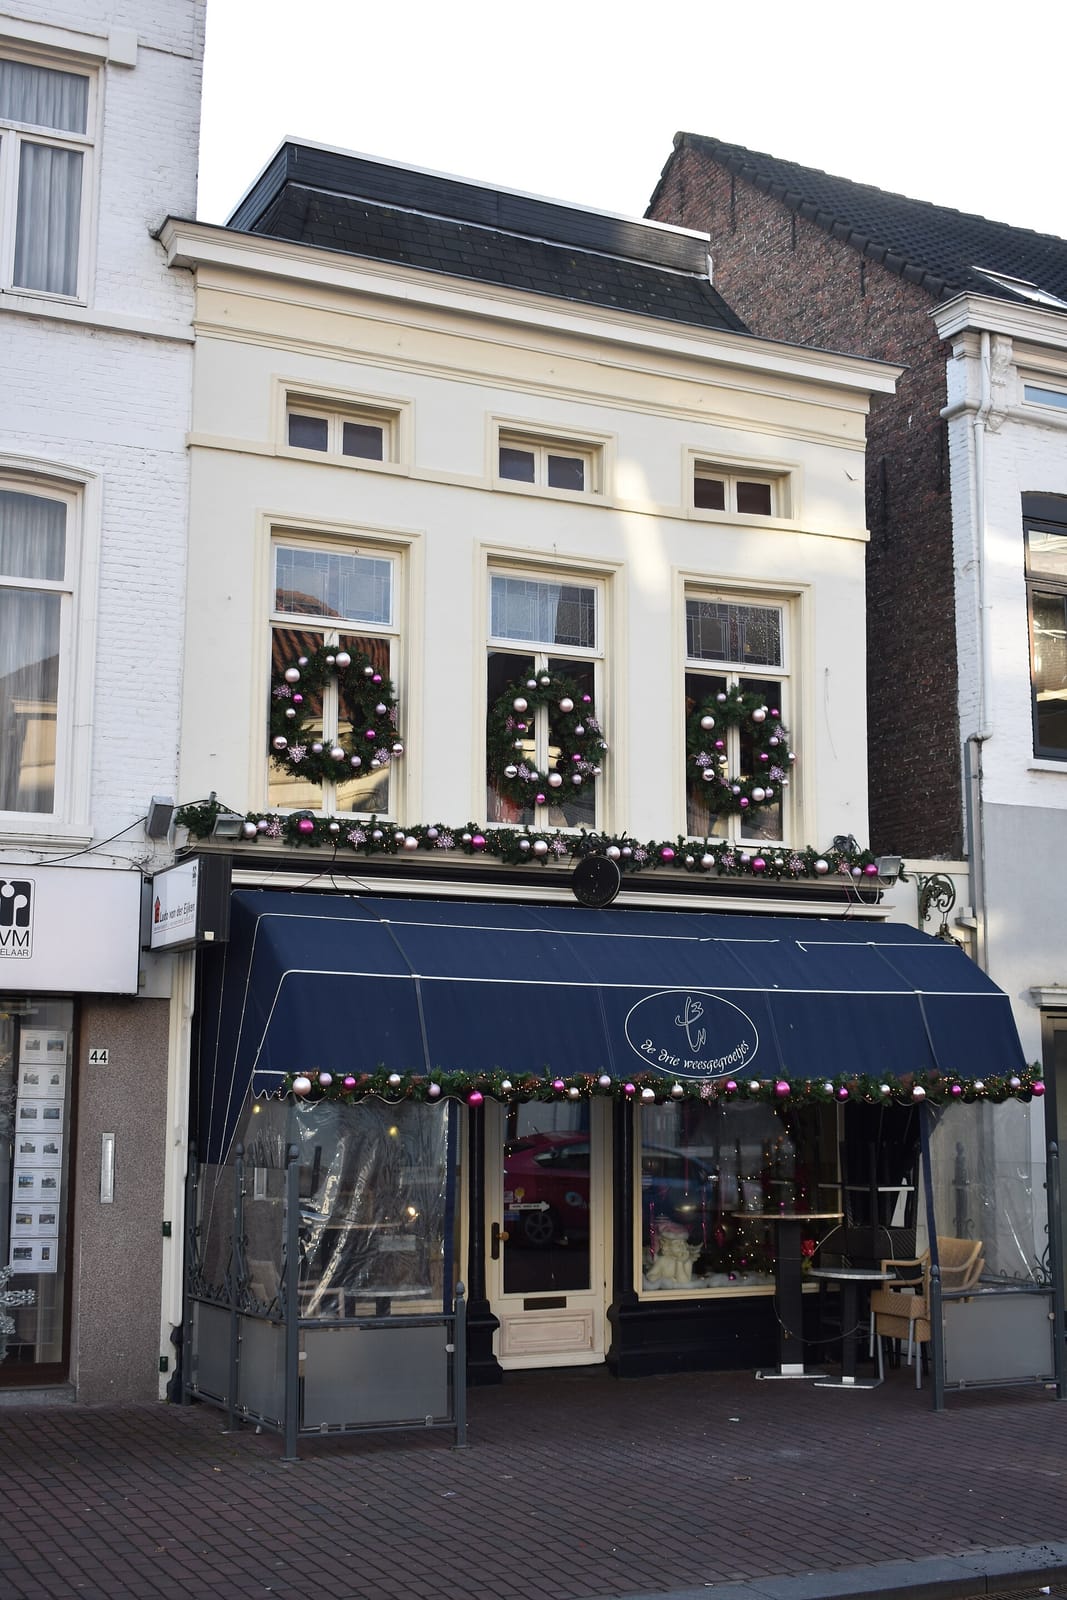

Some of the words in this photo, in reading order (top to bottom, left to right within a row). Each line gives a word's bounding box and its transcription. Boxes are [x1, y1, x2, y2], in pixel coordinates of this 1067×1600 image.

[90, 1050, 108, 1063] 44
[641, 1039, 656, 1054] de
[658, 1048, 681, 1067] drie
[684, 1040, 749, 1074] weesgegroetjes
